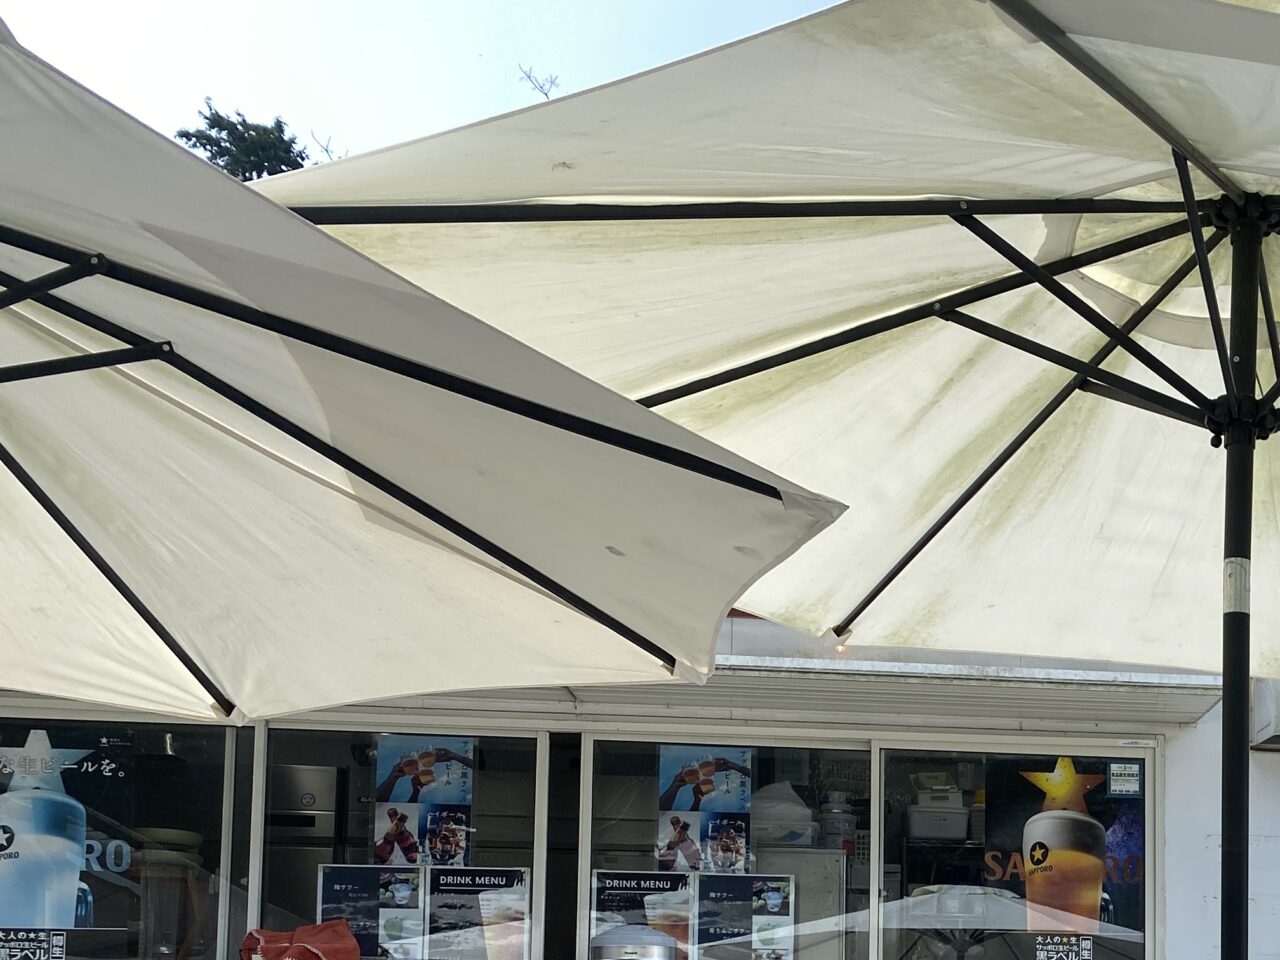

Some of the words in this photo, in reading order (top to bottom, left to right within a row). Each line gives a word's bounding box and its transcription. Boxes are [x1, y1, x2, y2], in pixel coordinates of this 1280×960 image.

[439, 875, 472, 885] DRINK
[475, 876, 506, 886] MENU
[606, 879, 638, 888] DRINK
[640, 880, 671, 889] MENU
